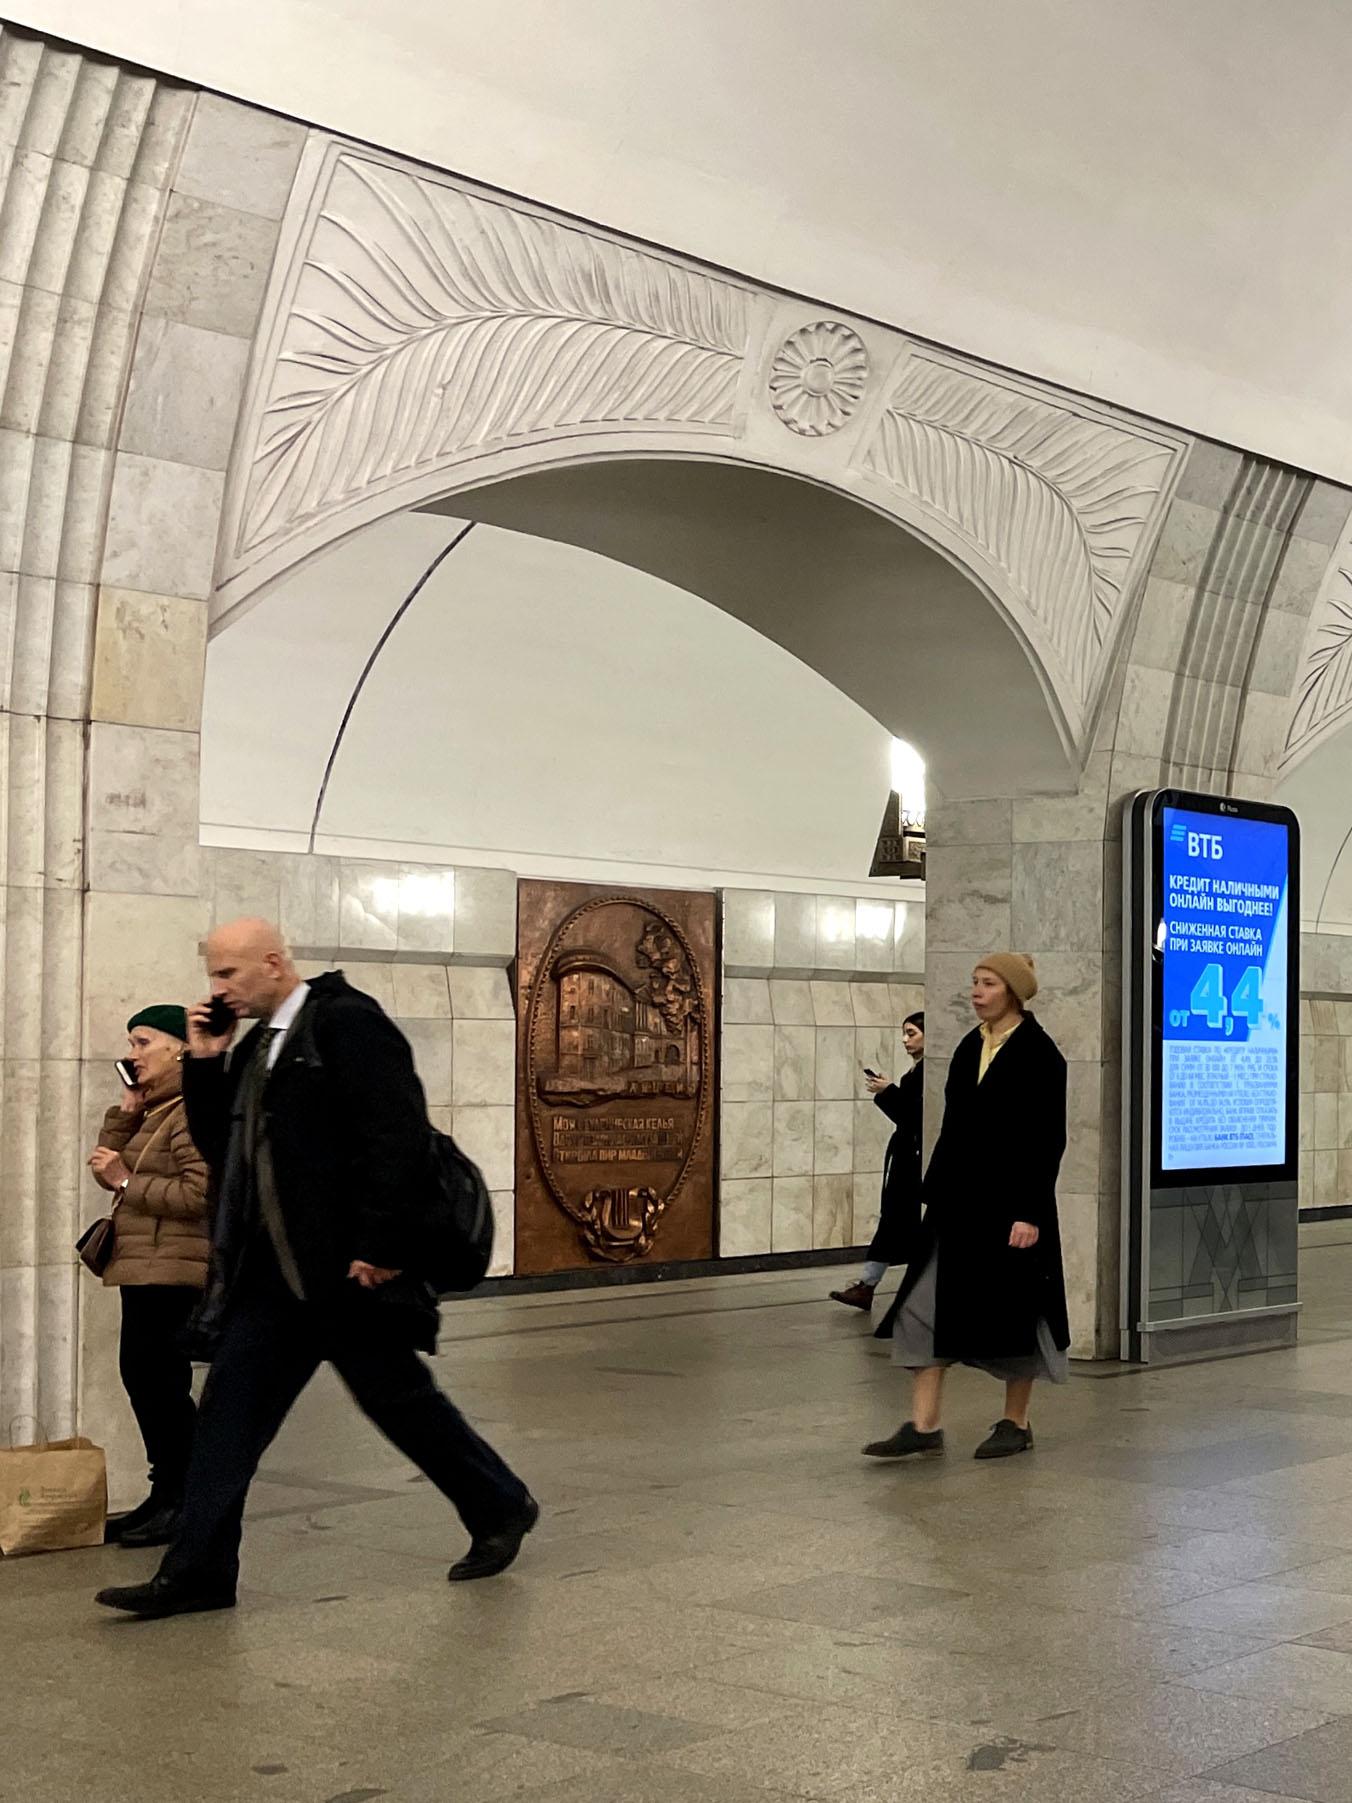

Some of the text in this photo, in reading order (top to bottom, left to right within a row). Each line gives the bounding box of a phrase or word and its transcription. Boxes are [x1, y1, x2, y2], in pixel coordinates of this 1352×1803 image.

[1188, 831, 1223, 860] ВТБ
[1169, 875, 1279, 900] КРЕДИТ НАЛИЧНЫМИ
[1169, 893, 1273, 917] ОНЛАЙН ВЫГОДНЕЕ!
[1169, 921, 1262, 941] СНИЖЕННАЯ СТАВКА
[1169, 938, 1263, 957] ПРИ ЗАЯВКЕ ОНЛАЙН
[1169, 1009, 1190, 1028] от
[1190, 963, 1264, 1036] 4,4
